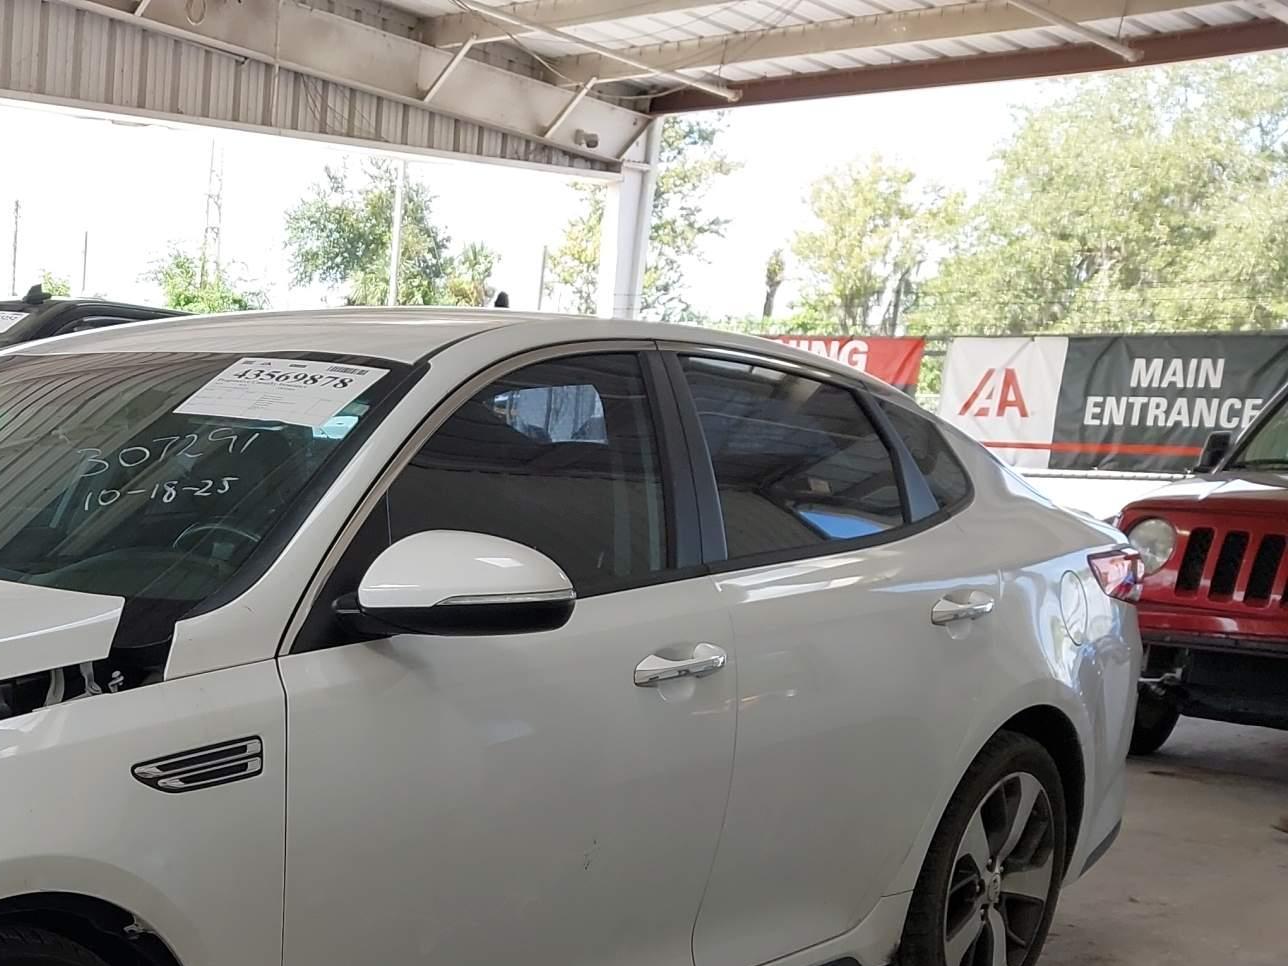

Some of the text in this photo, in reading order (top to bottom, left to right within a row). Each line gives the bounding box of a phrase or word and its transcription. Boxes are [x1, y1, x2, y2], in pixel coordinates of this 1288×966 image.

[233, 368, 354, 389] 43569878
[1129, 358, 1225, 388] MAIN
[1083, 396, 1264, 429] ENTRANCE
[77, 427, 260, 477] 307291
[84, 476, 240, 511] 10-18-25
